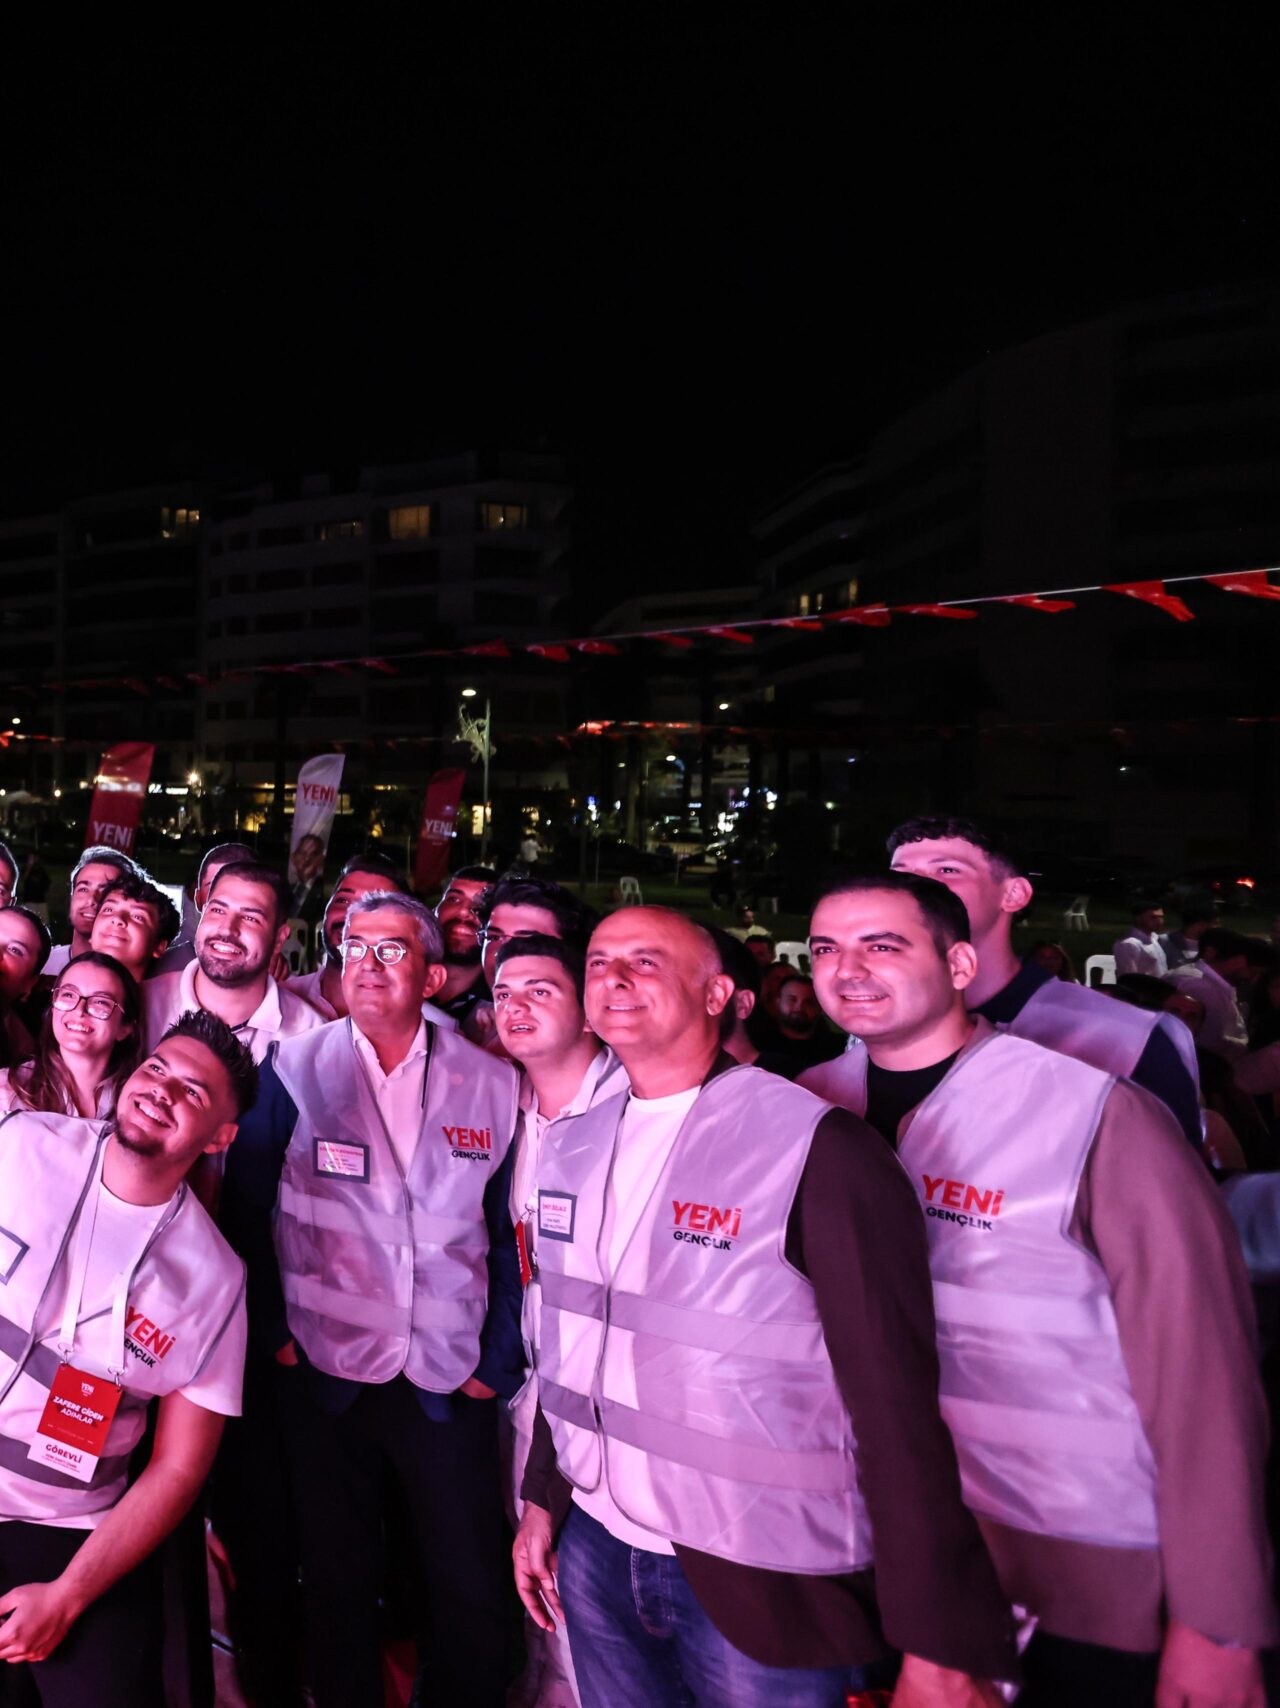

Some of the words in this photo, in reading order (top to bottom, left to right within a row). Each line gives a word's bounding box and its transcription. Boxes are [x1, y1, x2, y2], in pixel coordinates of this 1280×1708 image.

[53, 1395, 81, 1412] ZAFERE
[81, 1406, 104, 1422] GİDEN
[60, 1407, 93, 1425] ADIMLAR
[45, 1443, 83, 1463] GÖREVLİ
